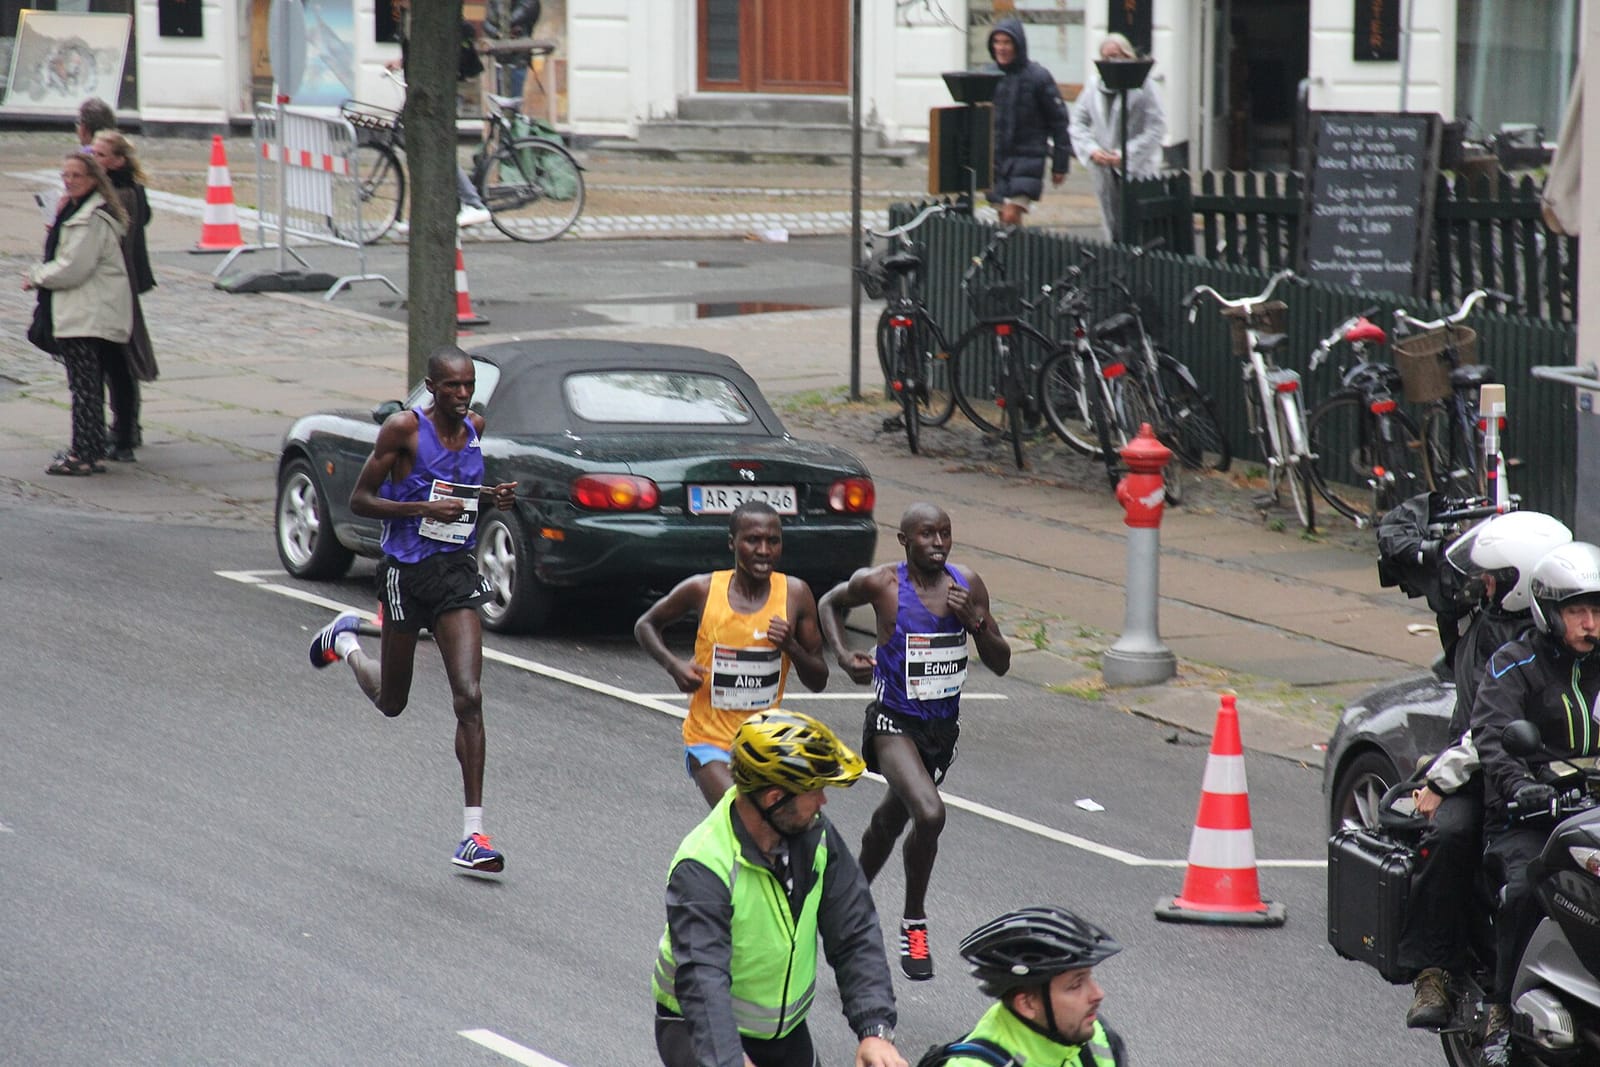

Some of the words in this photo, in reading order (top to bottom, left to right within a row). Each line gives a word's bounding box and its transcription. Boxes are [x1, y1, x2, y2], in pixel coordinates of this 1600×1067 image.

[1350, 154, 1415, 170] MENUER
[705, 489, 729, 508] AR
[924, 661, 958, 675] Edwin
[735, 675, 762, 688] Alex
